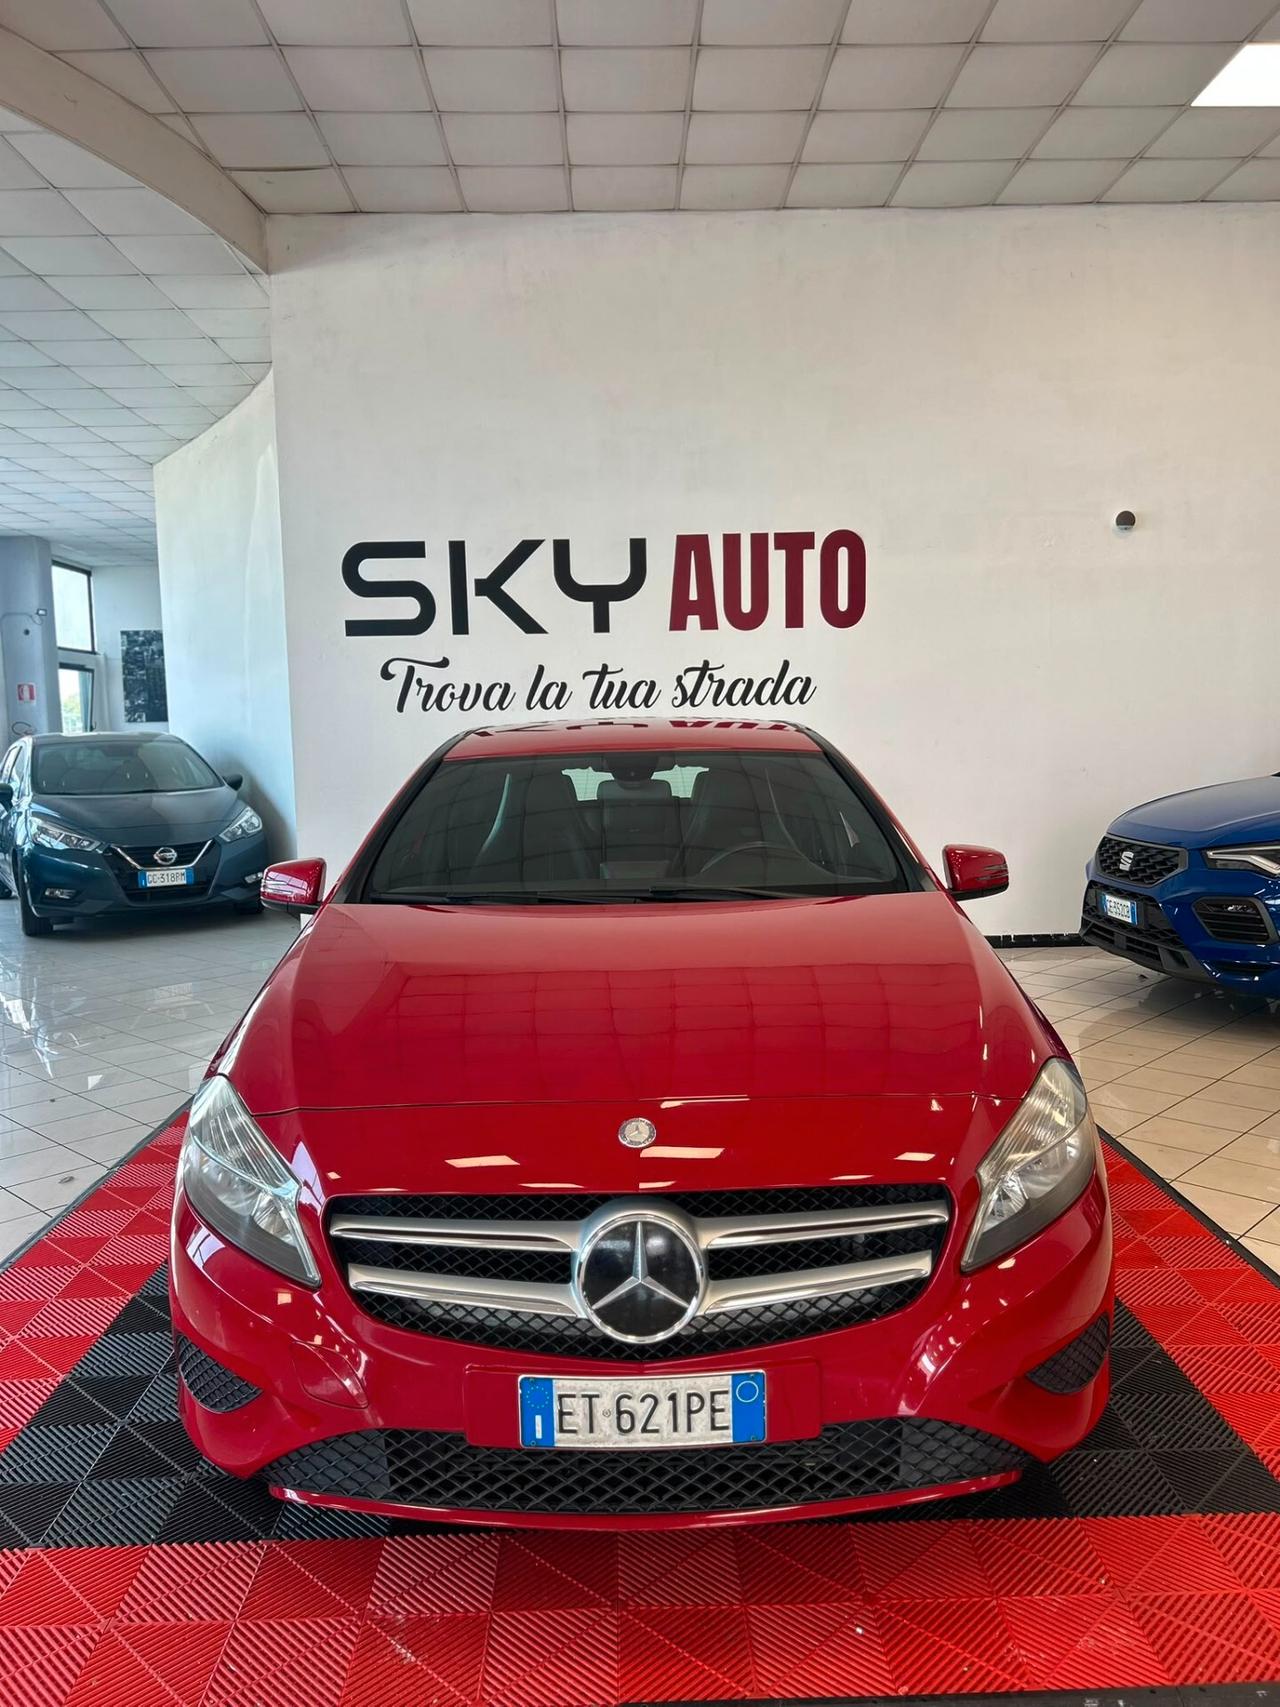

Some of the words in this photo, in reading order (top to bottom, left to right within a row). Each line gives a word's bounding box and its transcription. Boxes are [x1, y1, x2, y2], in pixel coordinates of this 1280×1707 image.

[342, 538, 647, 636] SKY
[669, 528, 867, 631] AUTO
[380, 656, 516, 713] Trova
[526, 664, 573, 711] la
[582, 663, 661, 709] tua
[671, 659, 817, 708] strada
[558, 1393, 600, 1434] ET
[615, 1390, 731, 1434] 621PE
